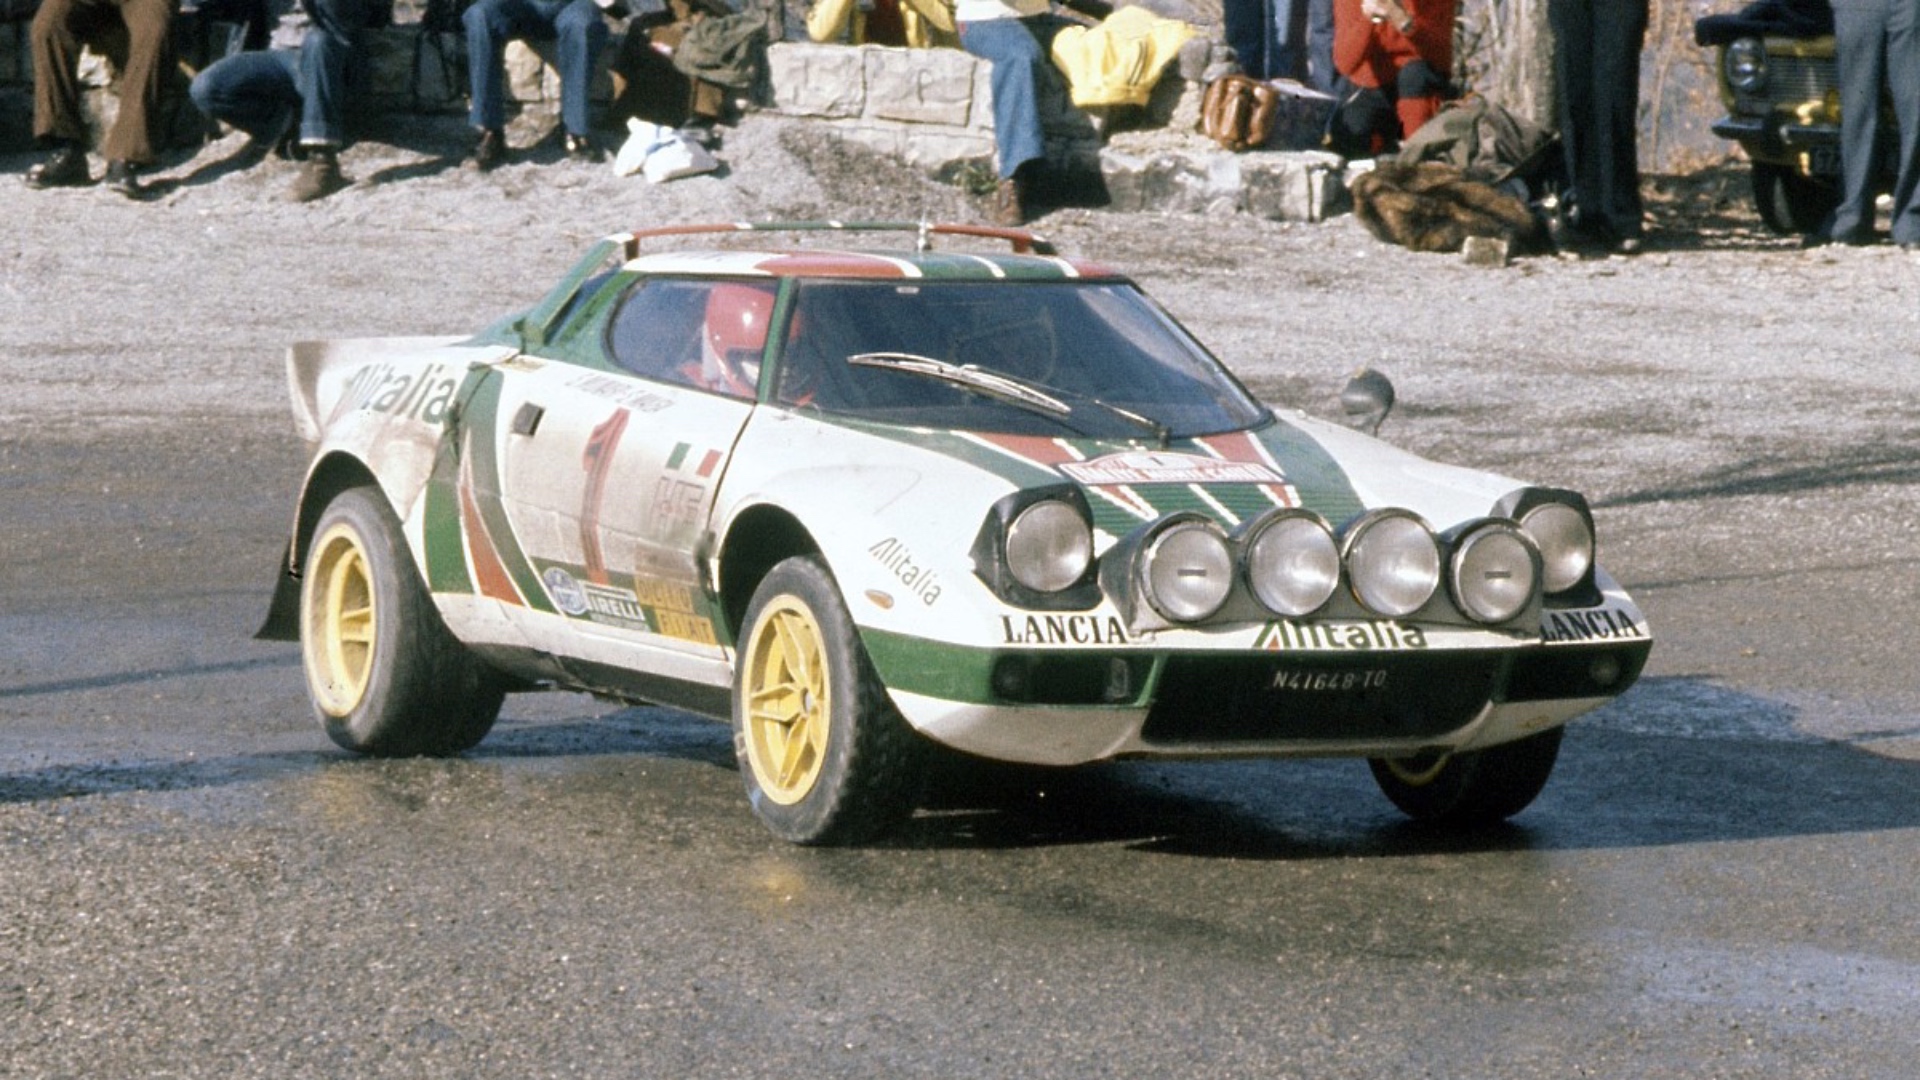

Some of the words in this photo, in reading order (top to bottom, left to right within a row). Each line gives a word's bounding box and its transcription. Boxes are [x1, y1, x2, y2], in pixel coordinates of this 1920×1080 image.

[343, 364, 456, 424] Alitalia
[868, 537, 942, 606] Alitalia
[1000, 614, 1128, 643] LANCIA
[1252, 620, 1428, 648] Alitalia
[1540, 608, 1644, 642] LANCIA
